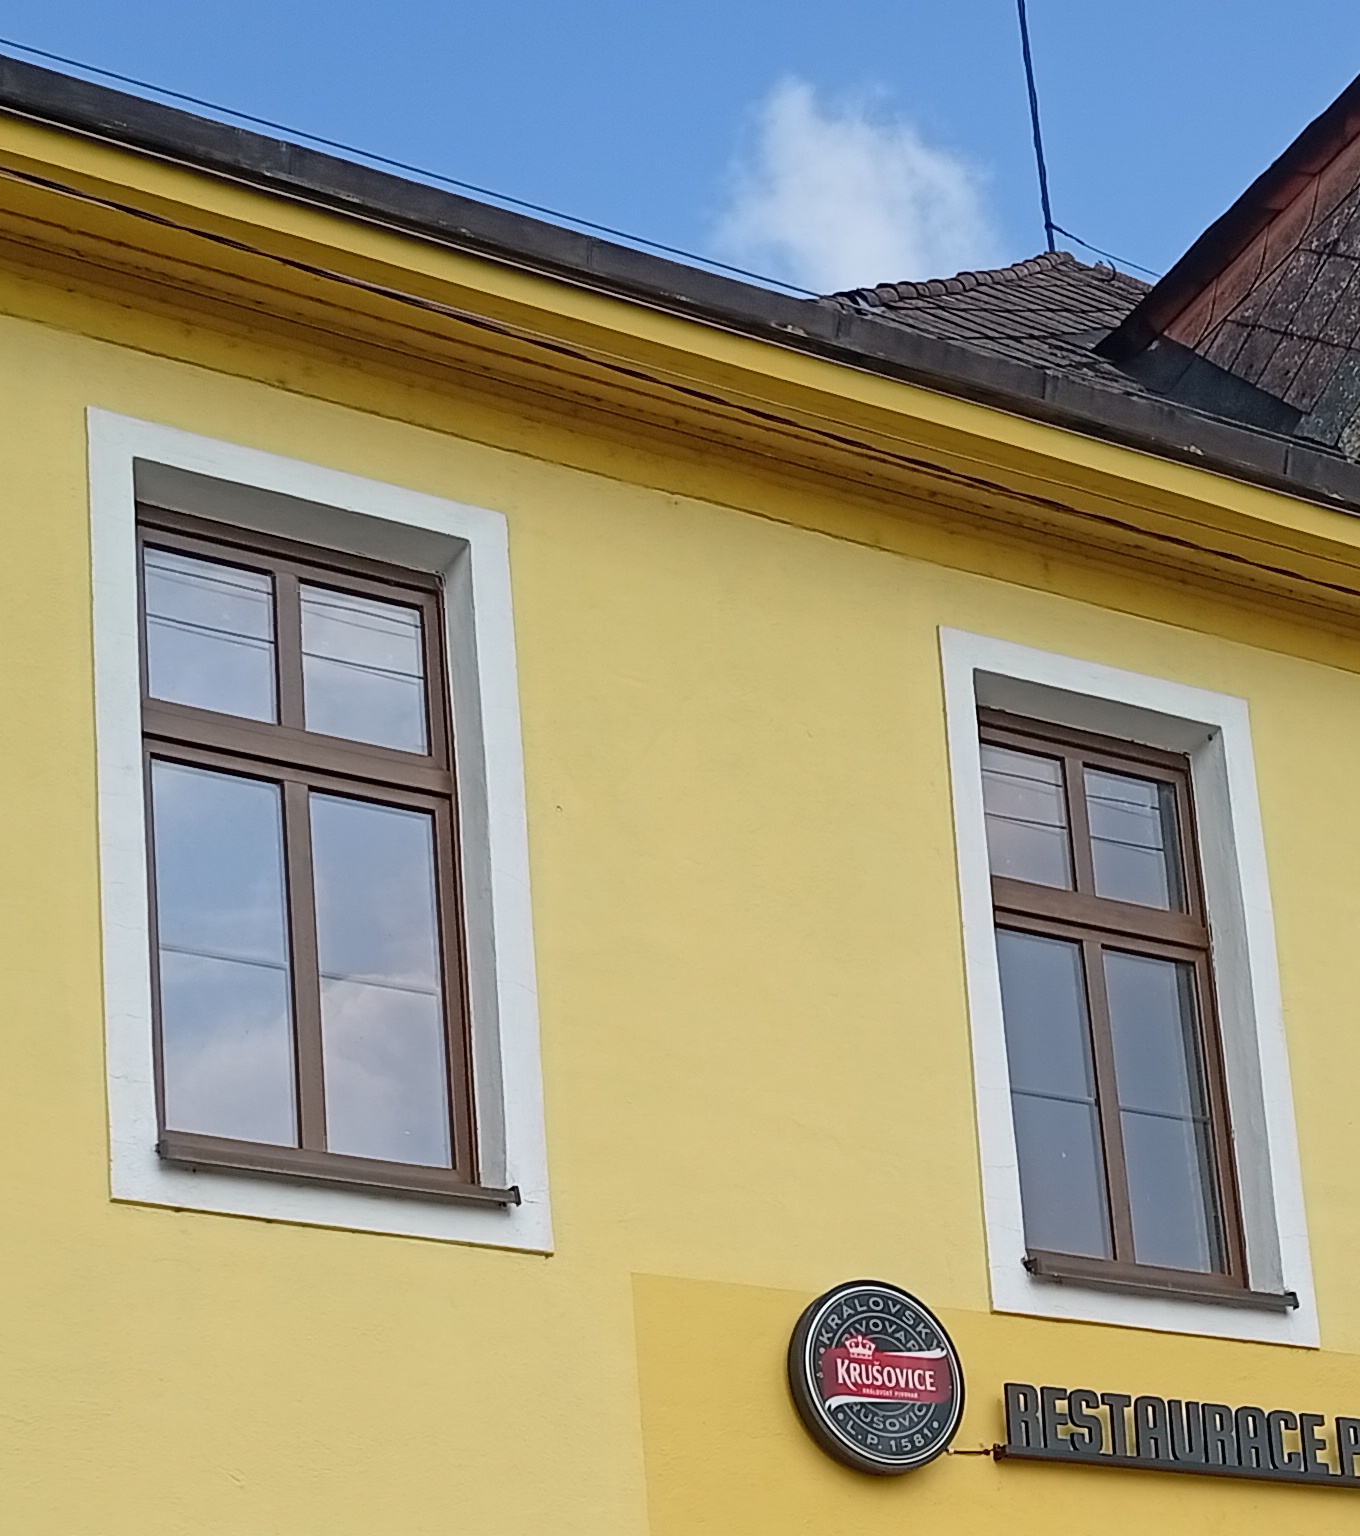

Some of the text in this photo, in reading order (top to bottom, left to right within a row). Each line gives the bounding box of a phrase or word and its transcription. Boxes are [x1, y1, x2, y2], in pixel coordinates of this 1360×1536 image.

[836, 1358, 936, 1391] KRUŠOVICE
[849, 1402, 927, 1431] RUŠOVIC
[1004, 1382, 1330, 1475] RESTAURACE
[889, 1427, 932, 1452] 1581
